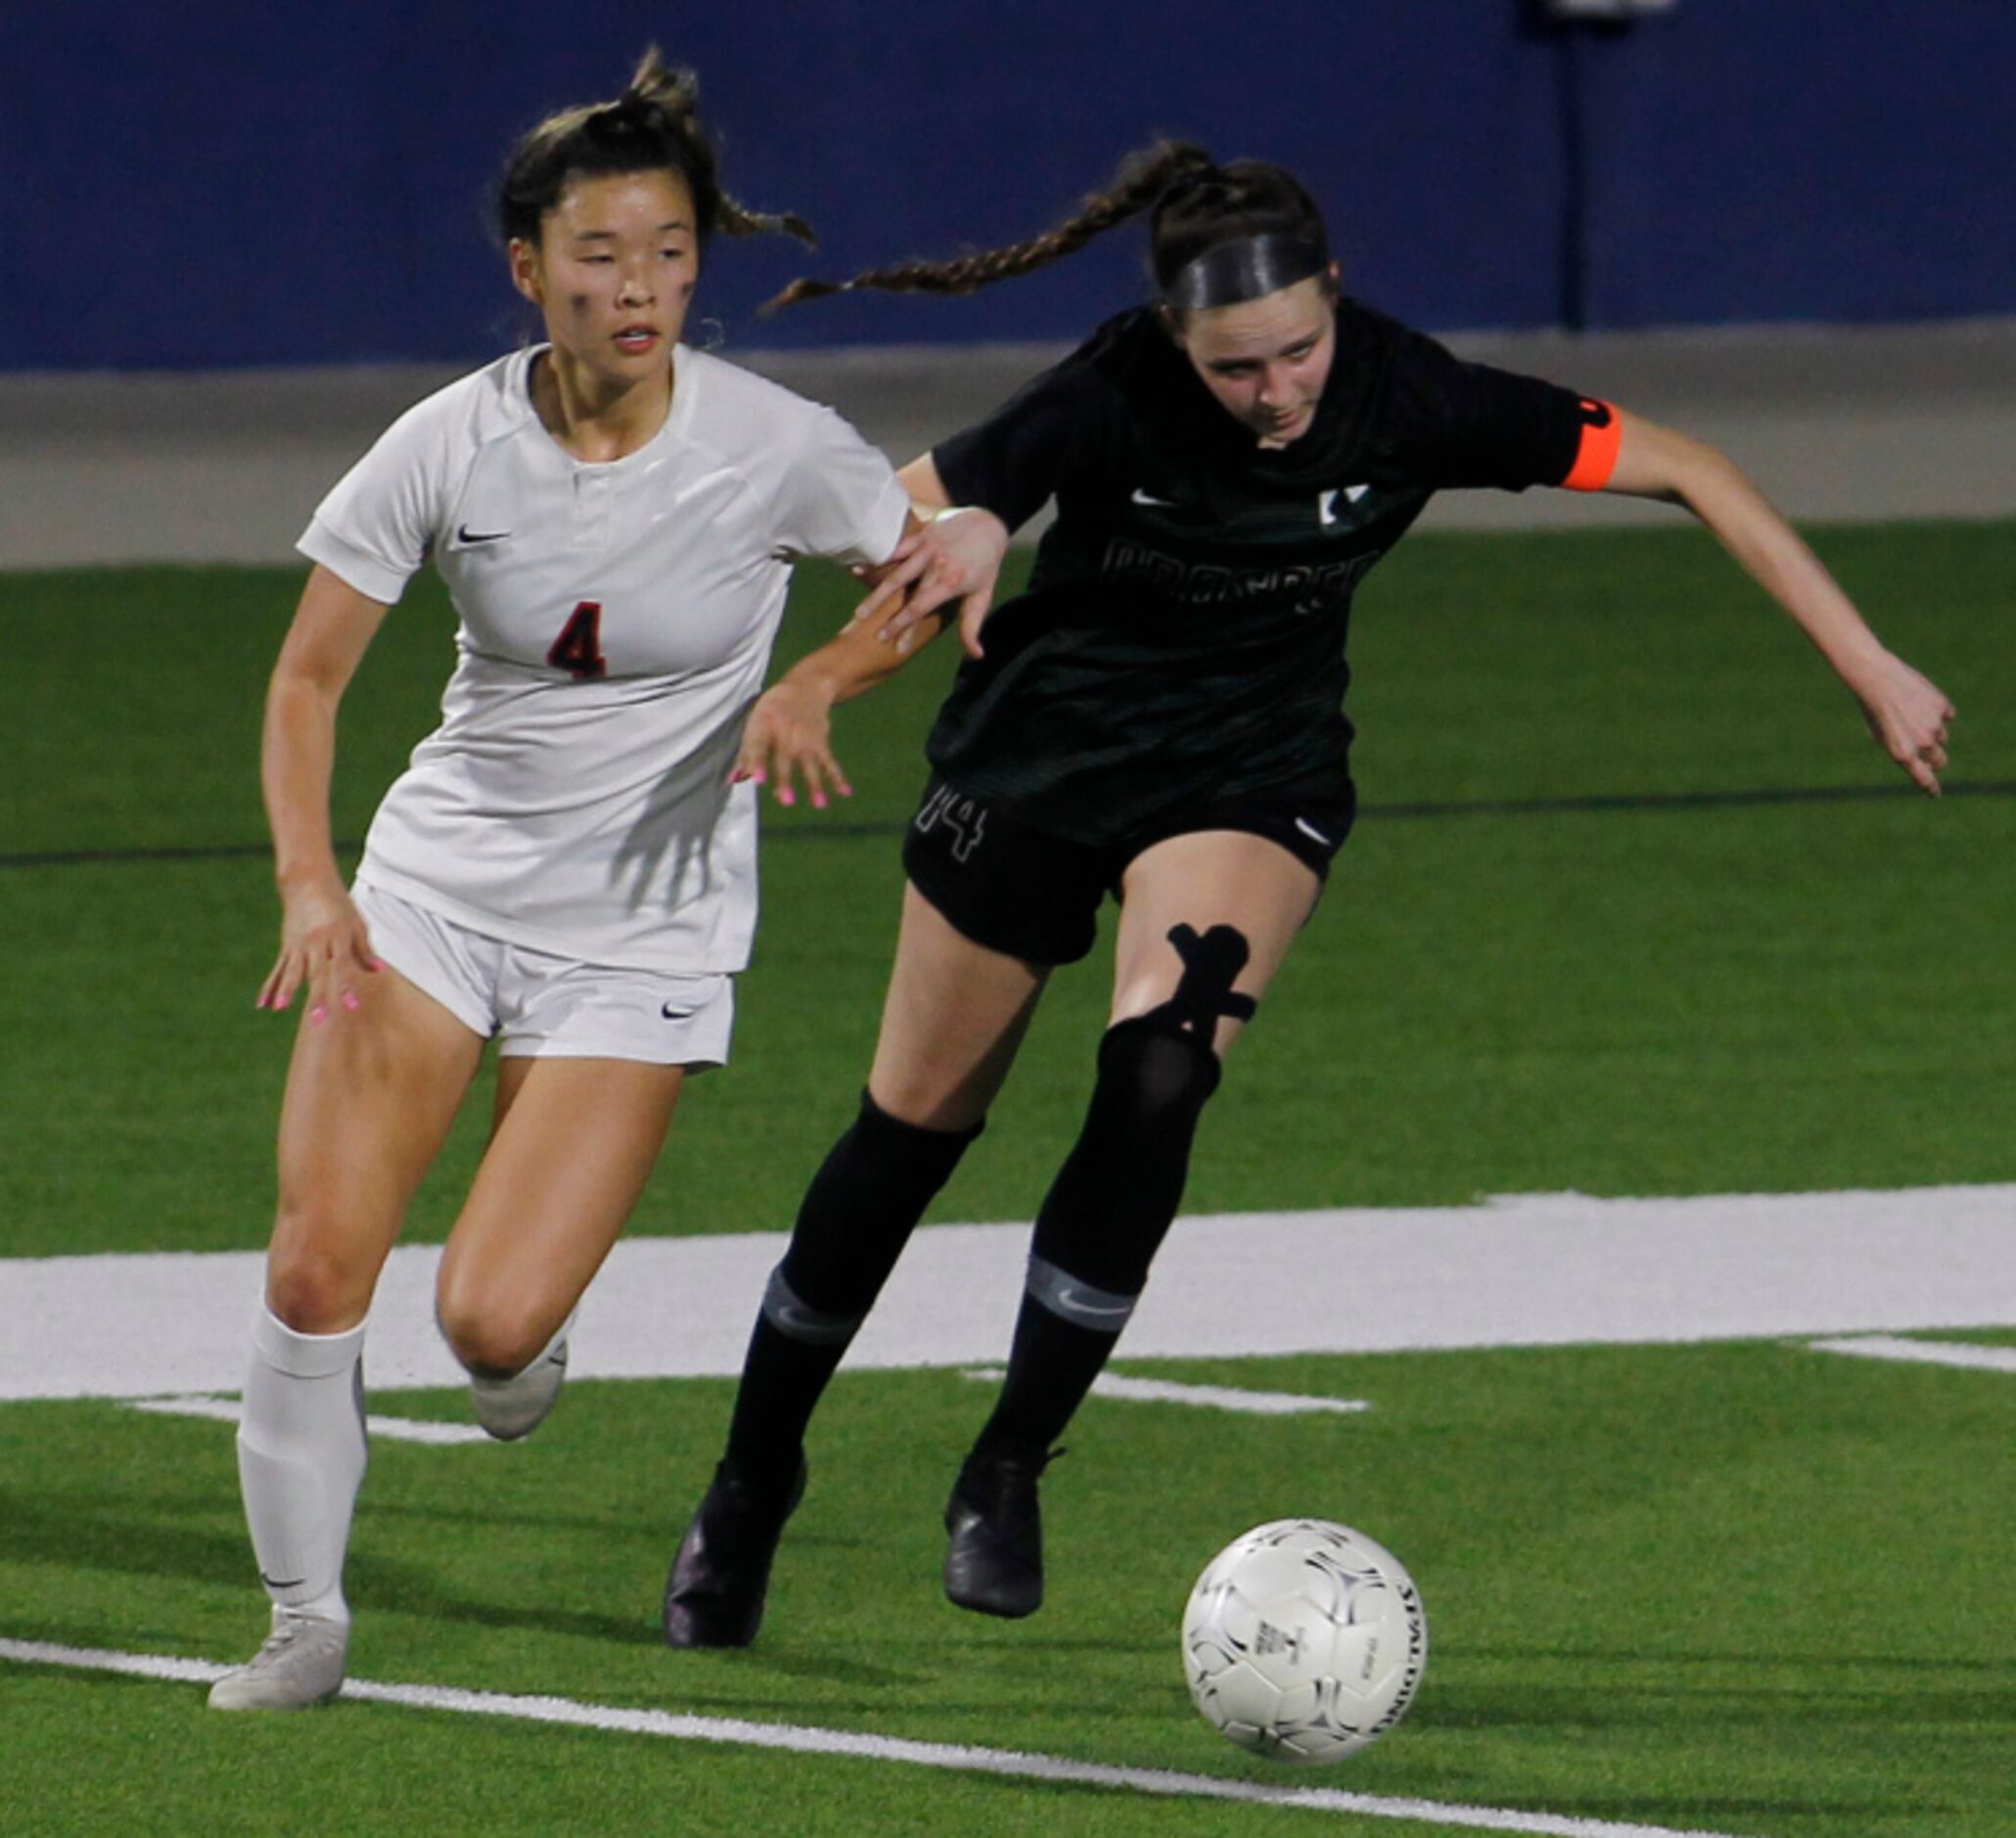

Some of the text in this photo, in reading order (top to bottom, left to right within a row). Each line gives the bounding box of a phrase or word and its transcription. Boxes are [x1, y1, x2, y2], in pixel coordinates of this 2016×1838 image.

[546, 602, 606, 681] 4
[914, 782, 987, 863] 14
[1371, 1584, 1422, 1733] SPALDING
